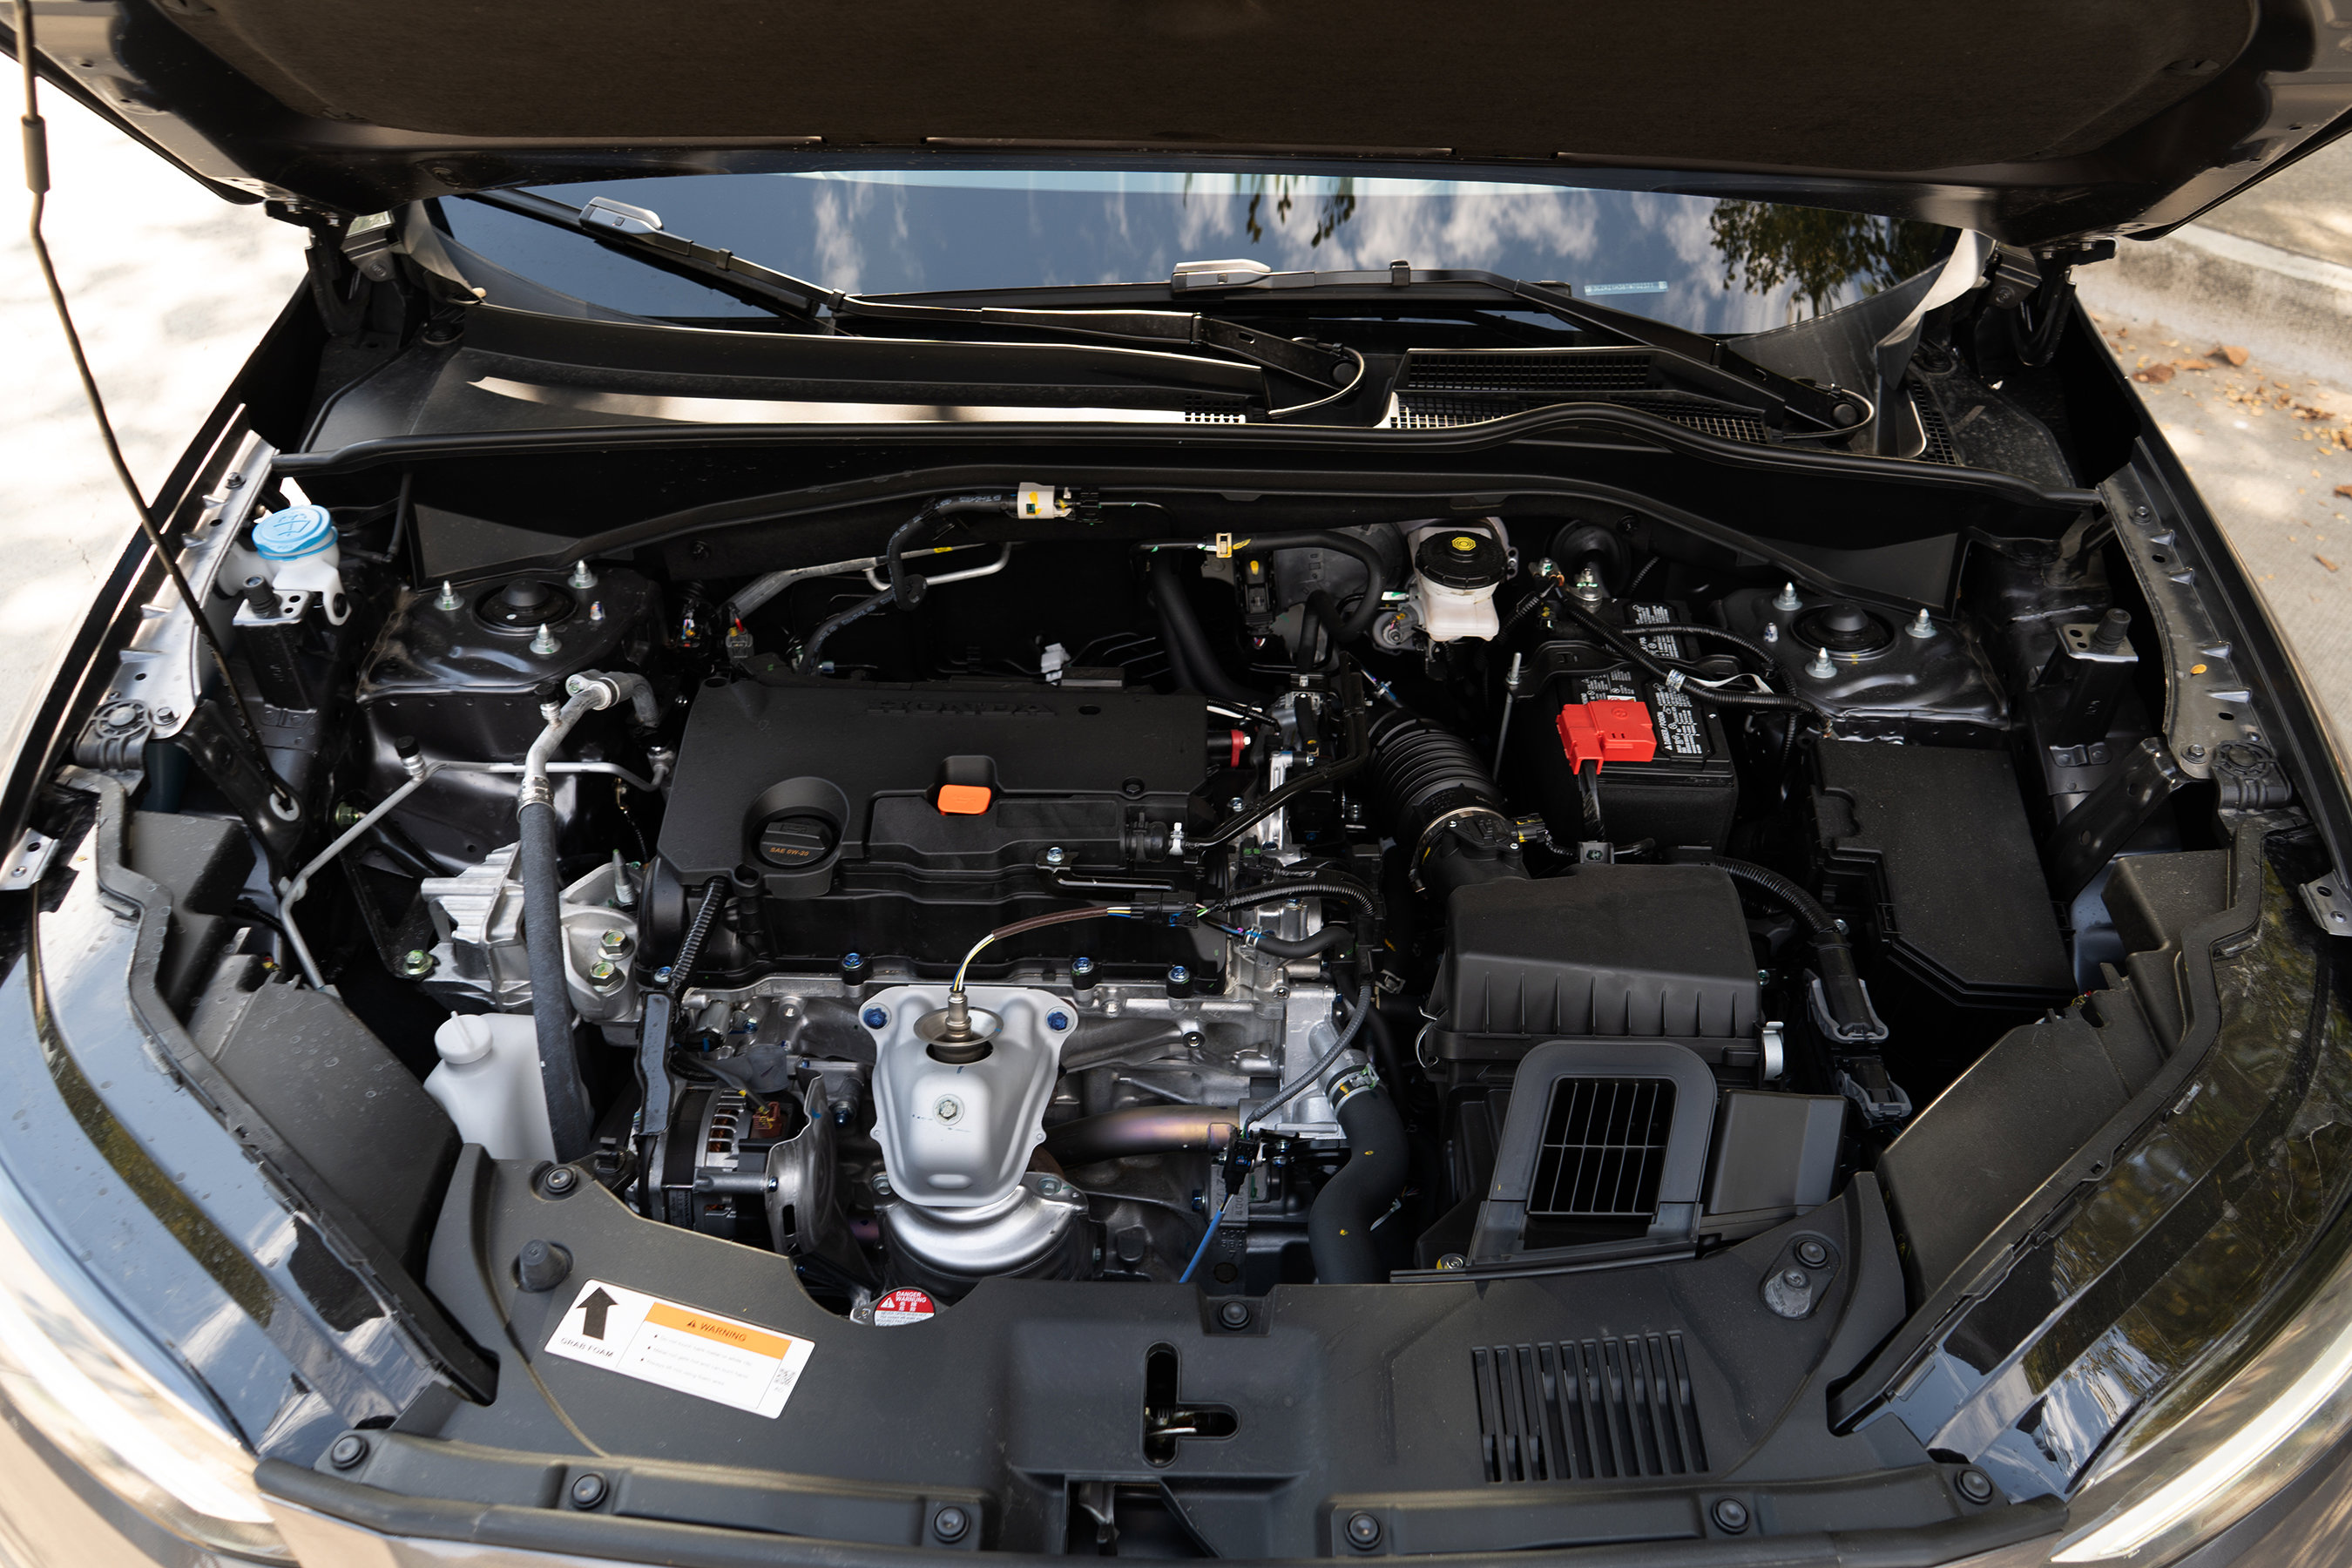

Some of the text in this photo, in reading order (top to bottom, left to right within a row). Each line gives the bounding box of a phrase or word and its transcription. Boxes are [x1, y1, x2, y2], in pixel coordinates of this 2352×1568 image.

[868, 700, 1057, 715] HONDA
[700, 1322, 747, 1342] WARNING
[560, 1337, 614, 1357] GRAB FOAM
